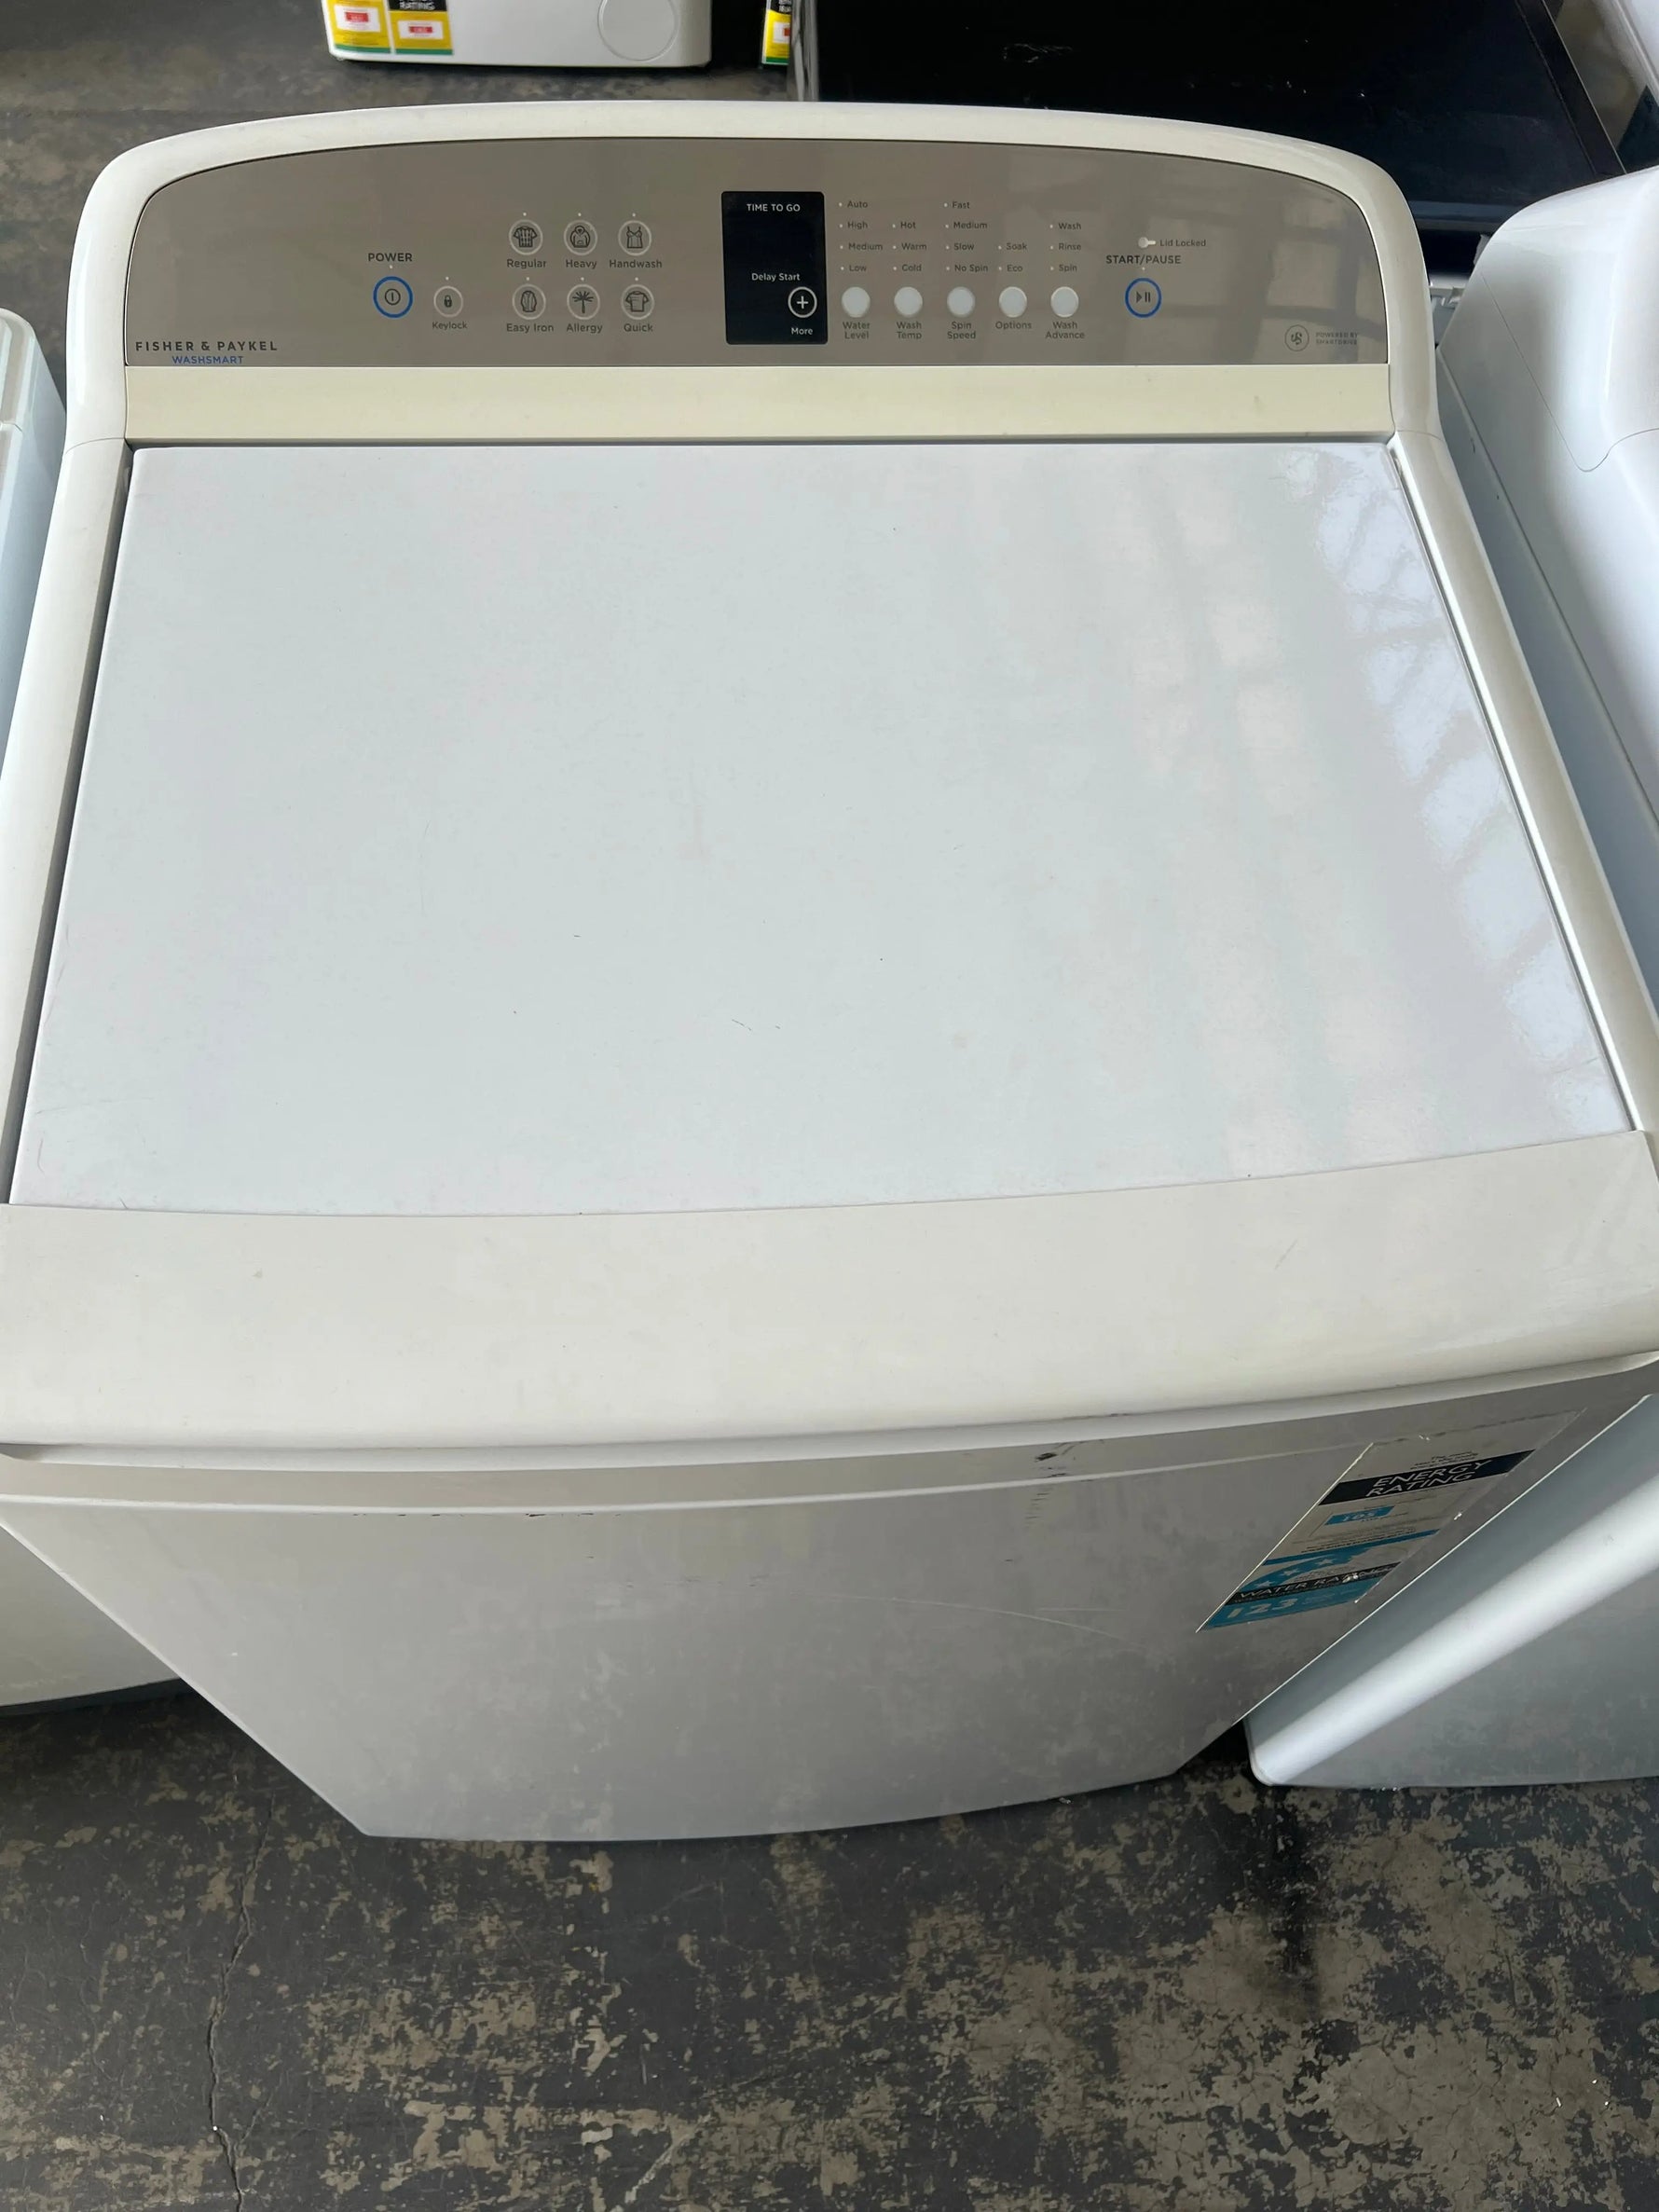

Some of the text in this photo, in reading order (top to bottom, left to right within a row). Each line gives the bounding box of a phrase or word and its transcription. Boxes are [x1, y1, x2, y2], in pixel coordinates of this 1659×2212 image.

[746, 203, 801, 213] TIME TO GO
[846, 199, 869, 209] Auto
[952, 200, 970, 210] Fast
[847, 221, 868, 231] High
[899, 221, 916, 229] Hot
[953, 221, 988, 230] Medium
[1058, 221, 1081, 230] Wash
[848, 242, 884, 251] Medium
[901, 242, 927, 251] Warm
[953, 242, 975, 251] Slow
[1006, 241, 1027, 251] Soak
[1058, 242, 1082, 251] Rinse
[1159, 239, 1206, 248] Lid Locked
[367, 252, 413, 262] POWER
[1105, 254, 1182, 265] START/PAUSE
[506, 258, 547, 269] Regular
[565, 258, 597, 269] Heavy
[609, 258, 663, 268] Handwash
[848, 264, 867, 272] Low
[901, 263, 922, 272] Cold
[1007, 264, 1023, 272] Eco
[954, 263, 989, 274] No Spin
[1058, 263, 1077, 274] Spin
[751, 272, 801, 283] Delay Start
[432, 320, 468, 331] Keylock
[506, 323, 555, 334] Easy Iron
[566, 323, 604, 334] Allergy
[623, 323, 653, 333] Quick
[843, 321, 871, 330] Water
[896, 321, 922, 330] Wash
[951, 321, 972, 331] Spin
[995, 320, 1032, 331] Options
[1052, 321, 1077, 330] Wash
[790, 327, 813, 336] More
[844, 331, 870, 340] Level
[897, 331, 923, 341] Temp
[947, 331, 977, 341] Speed
[1045, 331, 1085, 340] Advance
[135, 340, 278, 351] FISHER & PAYKEL
[171, 355, 243, 364] WASHSMART
[1372, 1460, 1493, 1488] ENERGY
[1364, 1471, 1476, 1498] RATING
[1241, 1581, 1308, 1598] WATER
[1227, 1598, 1298, 1618] 123
